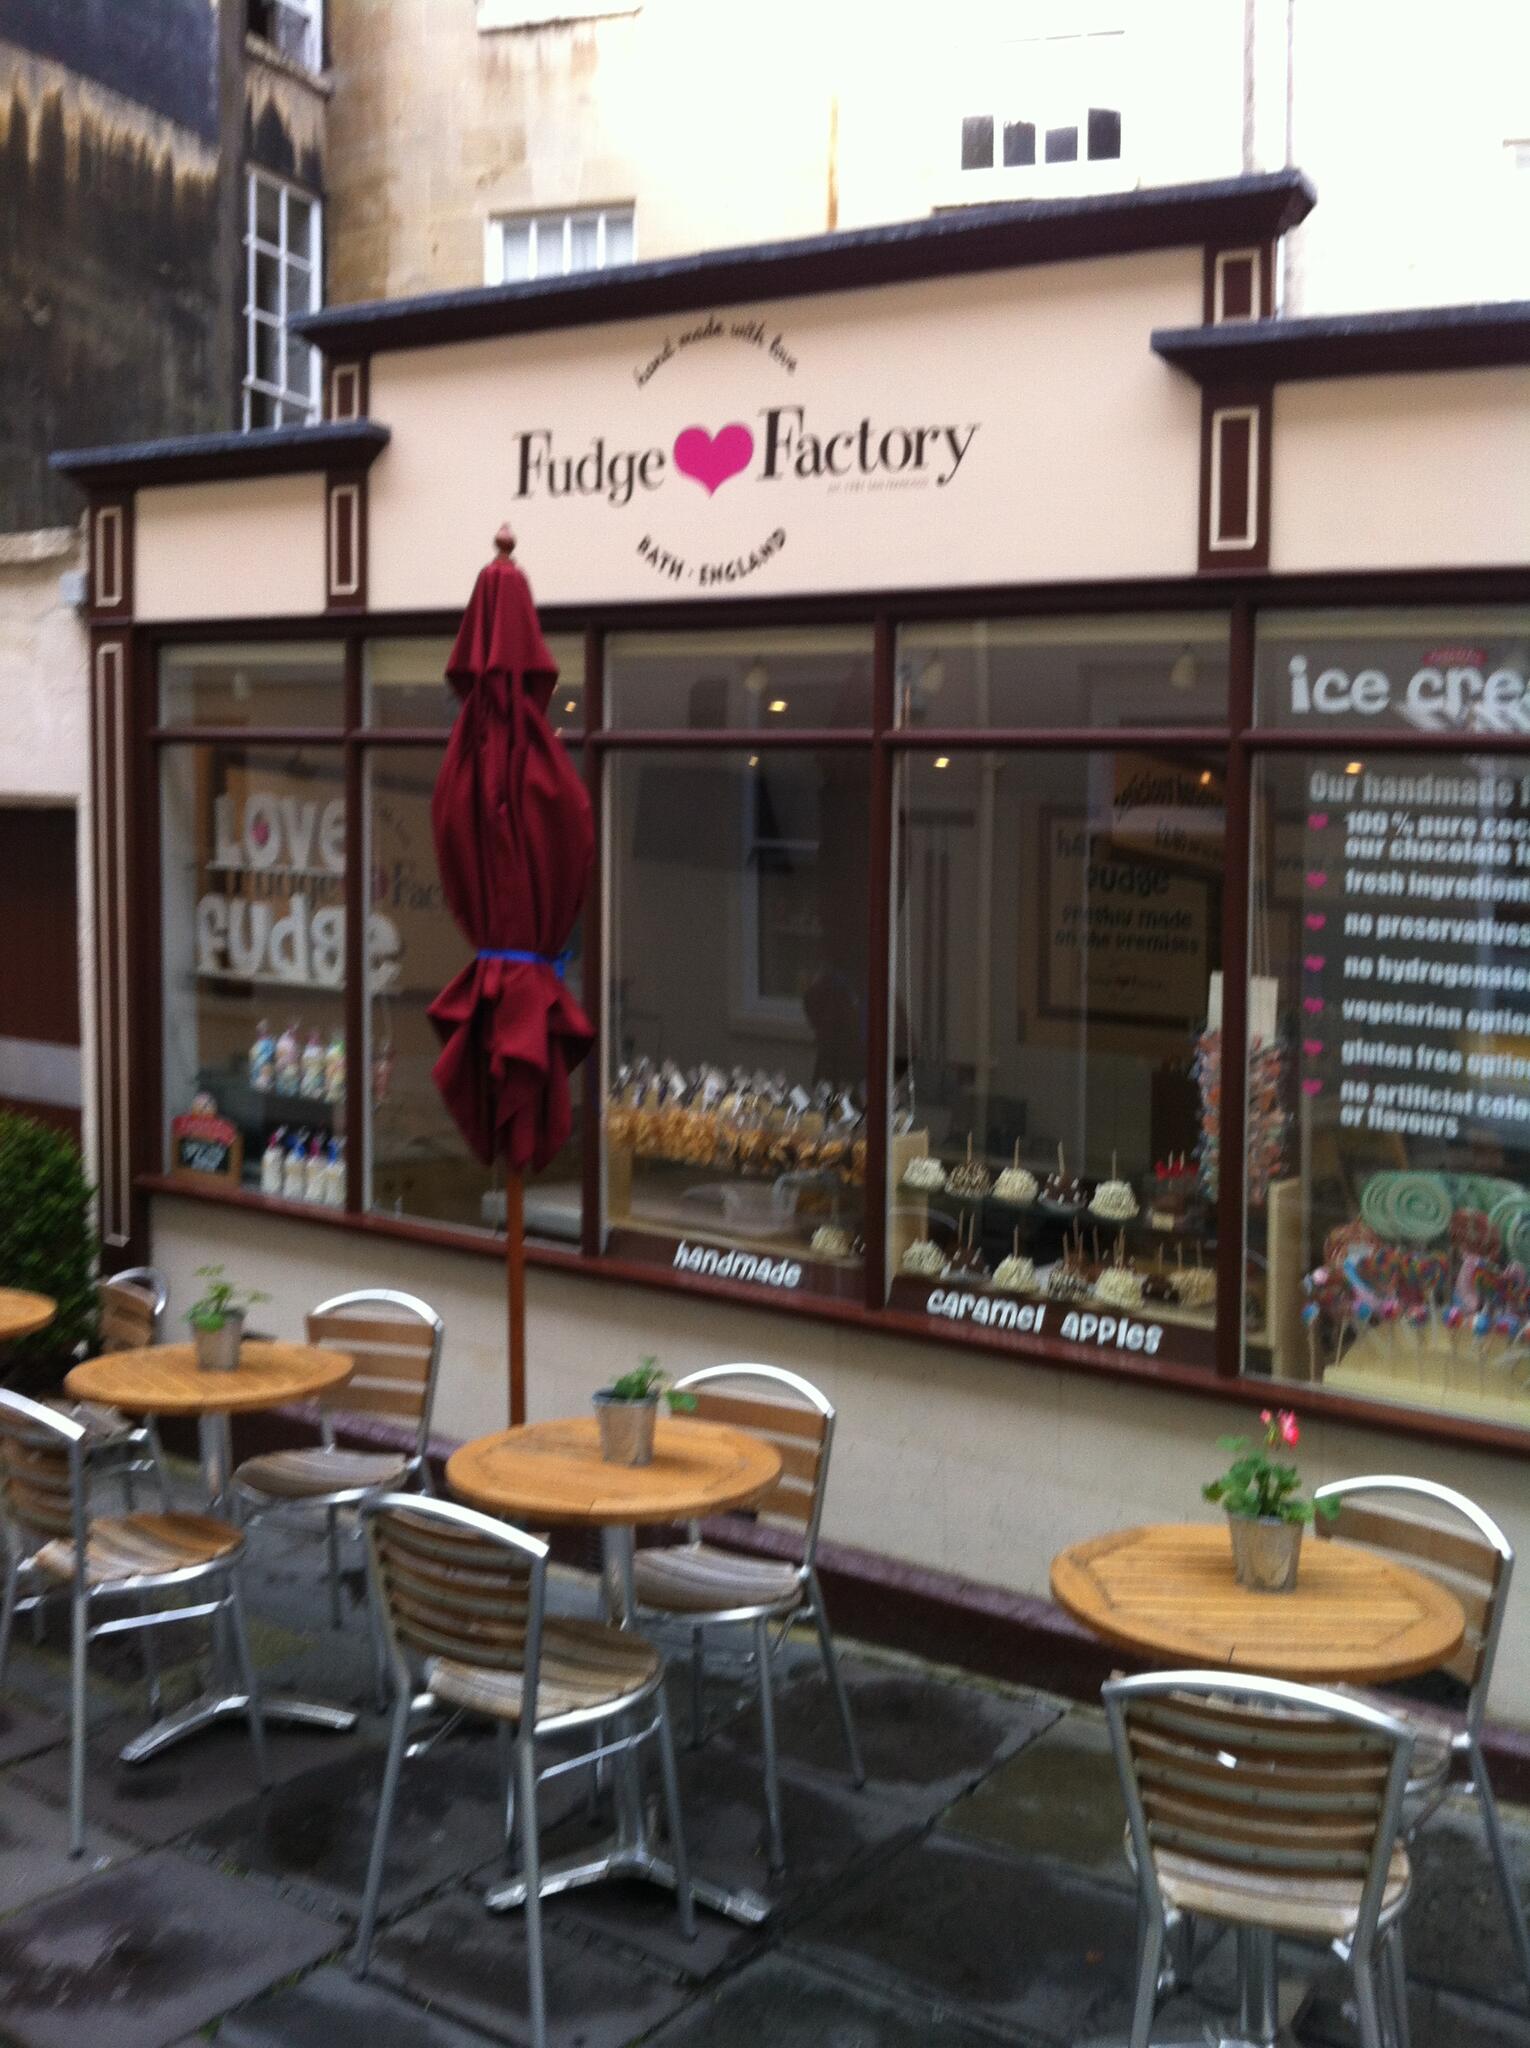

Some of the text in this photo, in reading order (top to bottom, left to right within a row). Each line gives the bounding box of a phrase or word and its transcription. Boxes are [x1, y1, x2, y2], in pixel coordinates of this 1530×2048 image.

[679, 315, 724, 349] made
[731, 320, 767, 348] with
[513, 405, 982, 508] Fudge Factory
[636, 527, 786, 587] BATH ENGLAND
[1288, 655, 1392, 715] ice
[1310, 771, 1358, 802] Our
[1362, 773, 1515, 808] handmade
[1389, 838, 1512, 865] chocolate
[1345, 868, 1405, 896] fresh
[1344, 912, 1373, 938] no
[1344, 954, 1530, 992] no hydrogenate
[1342, 999, 1530, 1037] vegetarian optio
[1341, 1038, 1530, 1080] gluten free optio
[1340, 1080, 1530, 1121] no artificial colo
[1340, 1104, 1459, 1139] or flavours
